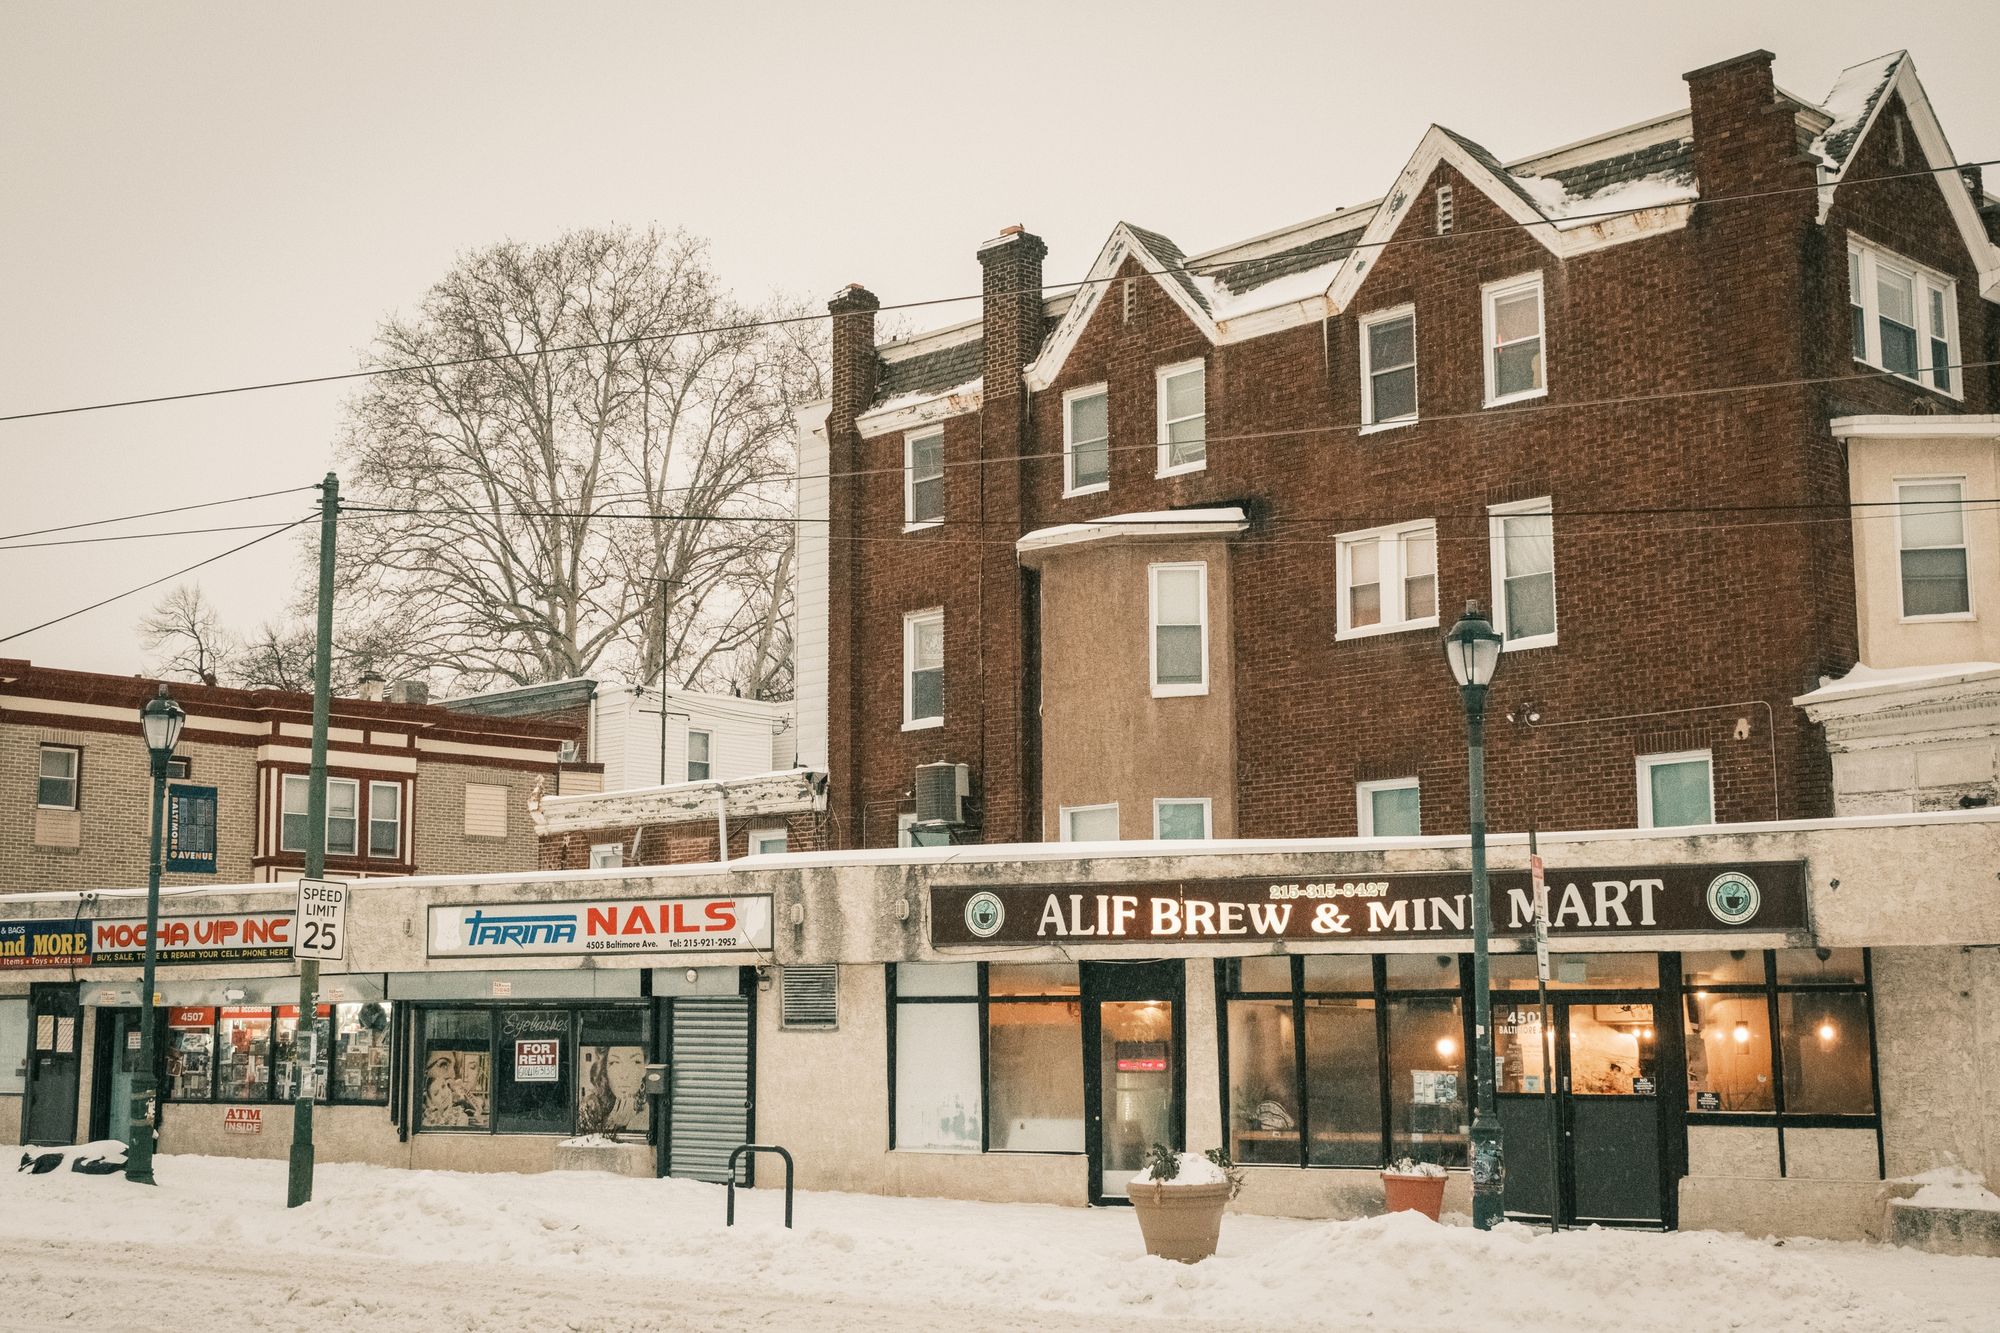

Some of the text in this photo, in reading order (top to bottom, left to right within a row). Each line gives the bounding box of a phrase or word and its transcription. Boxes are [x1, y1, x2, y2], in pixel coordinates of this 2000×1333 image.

[170, 797, 179, 850] BALTIMORE
[178, 851, 213, 860] AVENUE
[303, 887, 343, 903] SPEED
[1269, 882, 1389, 899] 215-315-8427
[306, 903, 338, 918] LIMIT
[1037, 893, 1138, 936] ALIF
[1150, 897, 1293, 937] BREW
[1311, 903, 1352, 934] &
[1506, 878, 1664, 929] MART
[587, 901, 737, 936] NAILS
[1, 926, 25, 935] & BAGS
[194, 918, 238, 945] VIP
[242, 917, 291, 944] INC
[303, 921, 337, 951] 25
[33, 933, 88, 956] MORE
[586, 938, 737, 949] 4505 Baltimore Ave. Tel: 215-921-2952
[3, 957, 24, 966] Items
[31, 957, 47, 965] Toys
[96, 948, 289, 962] BUY, SALE, TRE & REPAIR YOUR CELL PHONE HERE
[181, 1012, 204, 1022] 4507
[1507, 1011, 1541, 1024] 4501
[502, 1012, 569, 1038] Eyelashes
[523, 1043, 551, 1054] FOR
[518, 1054, 555, 1065] RENT
[225, 1108, 262, 1121] ATM
[225, 1122, 262, 1132] INSIDE
